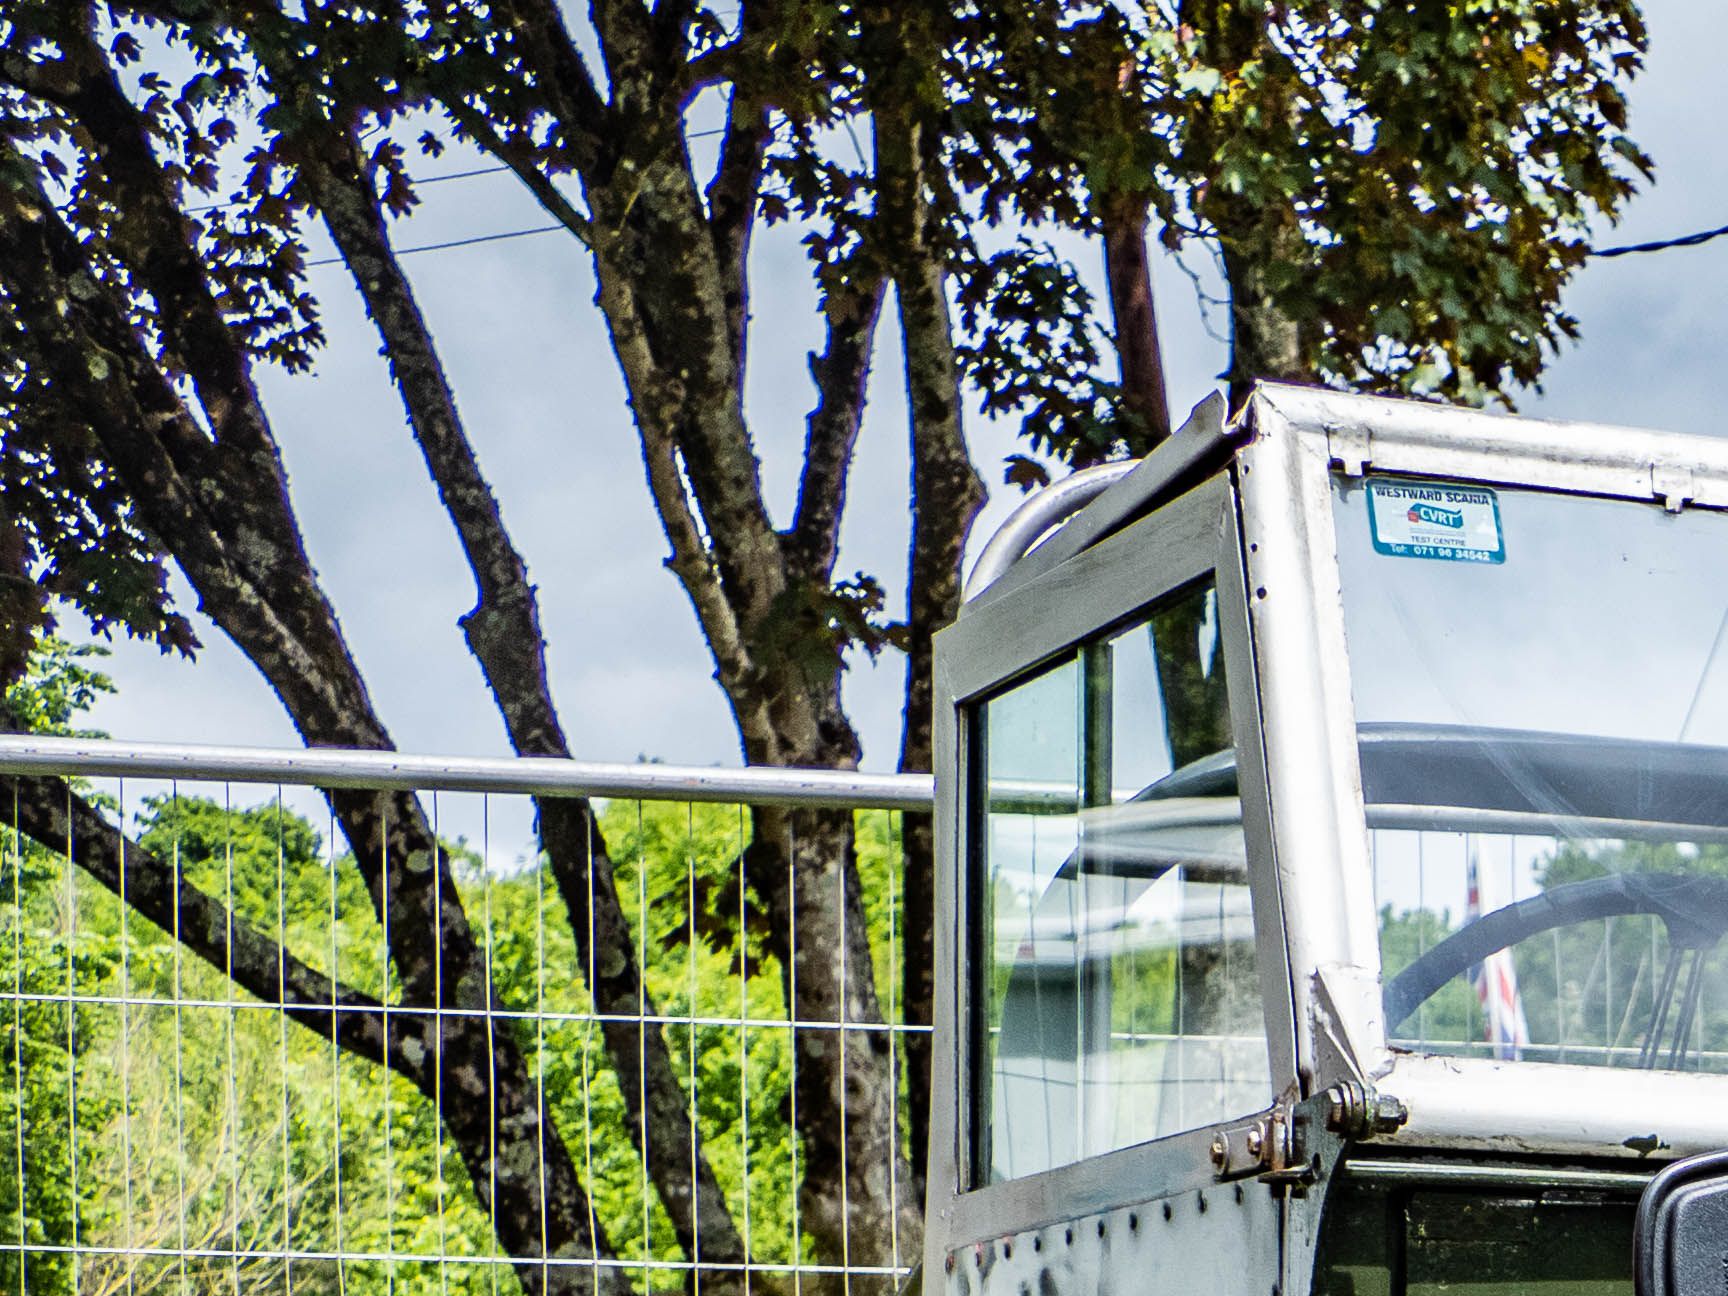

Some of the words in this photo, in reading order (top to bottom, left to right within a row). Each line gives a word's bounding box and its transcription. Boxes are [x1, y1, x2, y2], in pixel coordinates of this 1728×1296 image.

[1375, 486, 1442, 502] WESTWARD
[1446, 492, 1490, 505] SCANIA
[1420, 508, 1456, 525] CVRT
[1411, 536, 1431, 544] TEST
